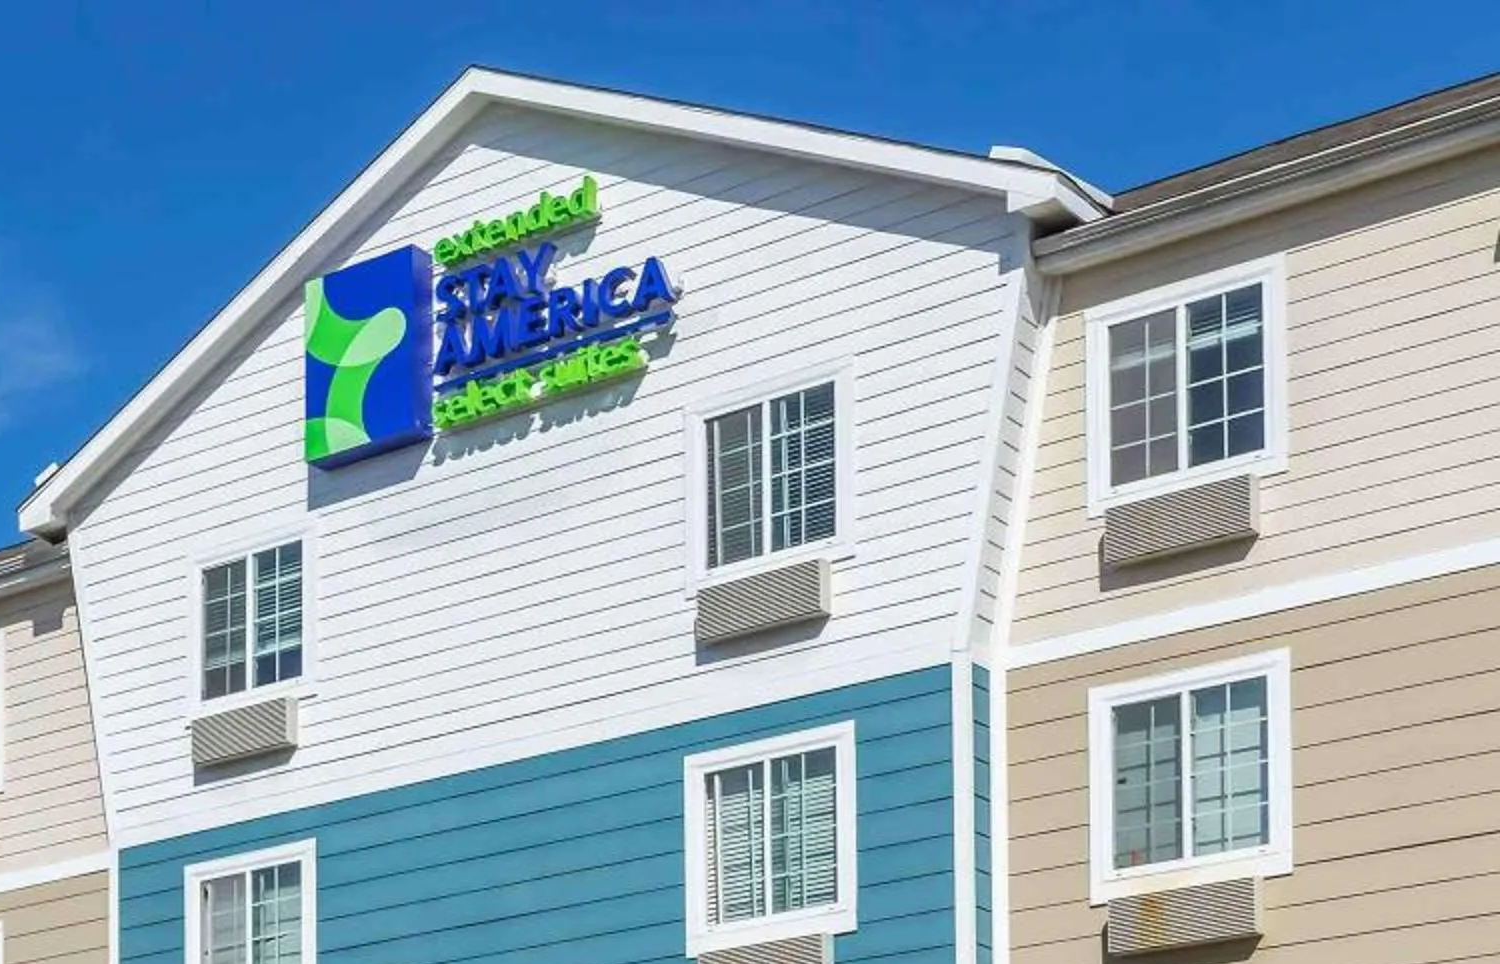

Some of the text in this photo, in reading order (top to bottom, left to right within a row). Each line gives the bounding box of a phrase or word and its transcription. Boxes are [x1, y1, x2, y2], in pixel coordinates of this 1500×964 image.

[433, 176, 598, 264] extended
[434, 257, 674, 376] AMERICA
[435, 242, 557, 318] STAY
[432, 337, 644, 431] select suites
